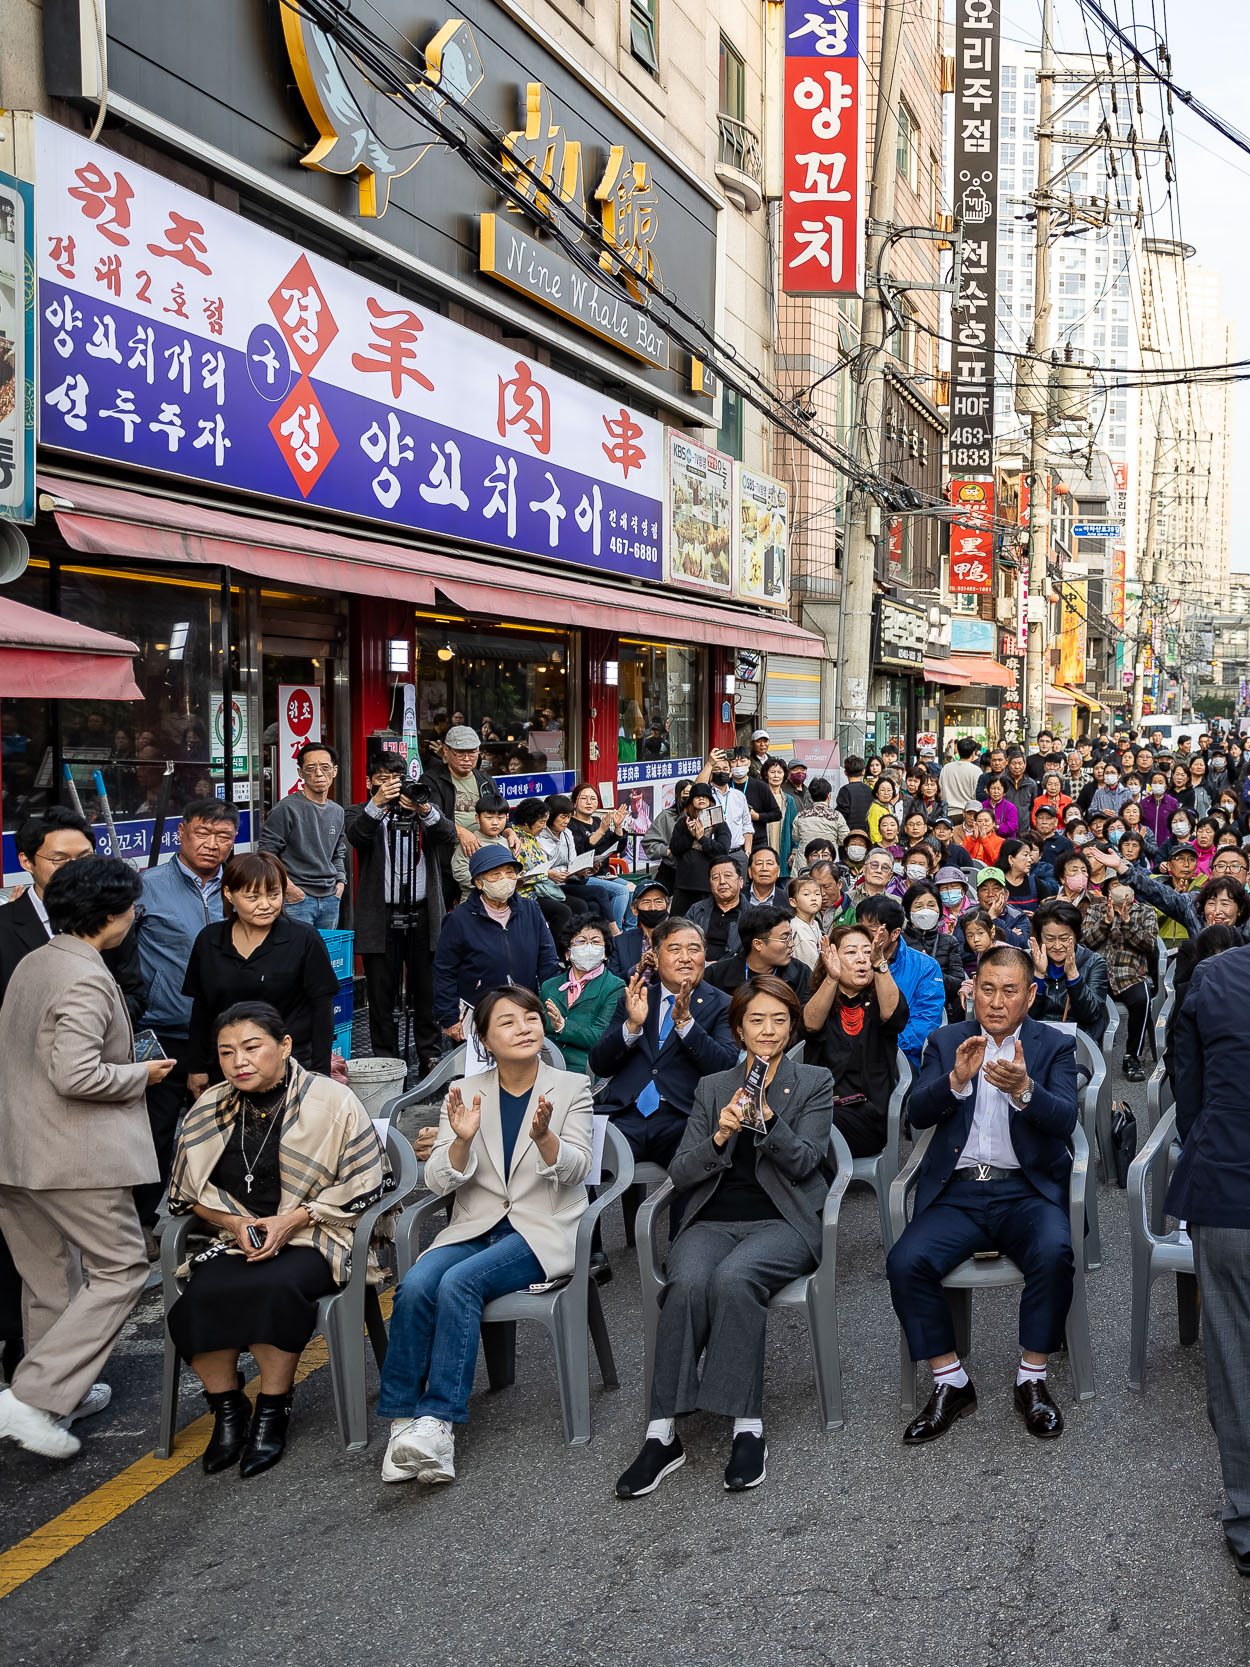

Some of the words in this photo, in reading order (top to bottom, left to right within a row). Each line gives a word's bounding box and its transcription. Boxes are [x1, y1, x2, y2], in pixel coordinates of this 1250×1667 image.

[788, 0, 849, 56] 성
[960, 0, 993, 153] 요리주점
[68, 161, 212, 275] 원조
[788, 71, 853, 283] 양꼬치
[507, 236, 562, 298] Nine
[571, 273, 629, 338] Whale
[636, 313, 664, 358] Bar
[45, 294, 226, 406] 양꼬치거리
[351, 296, 646, 479] 羊肉串
[45, 373, 232, 467] 선두주자
[951, 427, 991, 446] 463-
[951, 449, 990, 467] 1833
[955, 397, 989, 416] HOF
[360, 411, 602, 556] 양꼬치구이
[610, 536, 658, 563] 467-6880
[288, 700, 312, 723] 원조
